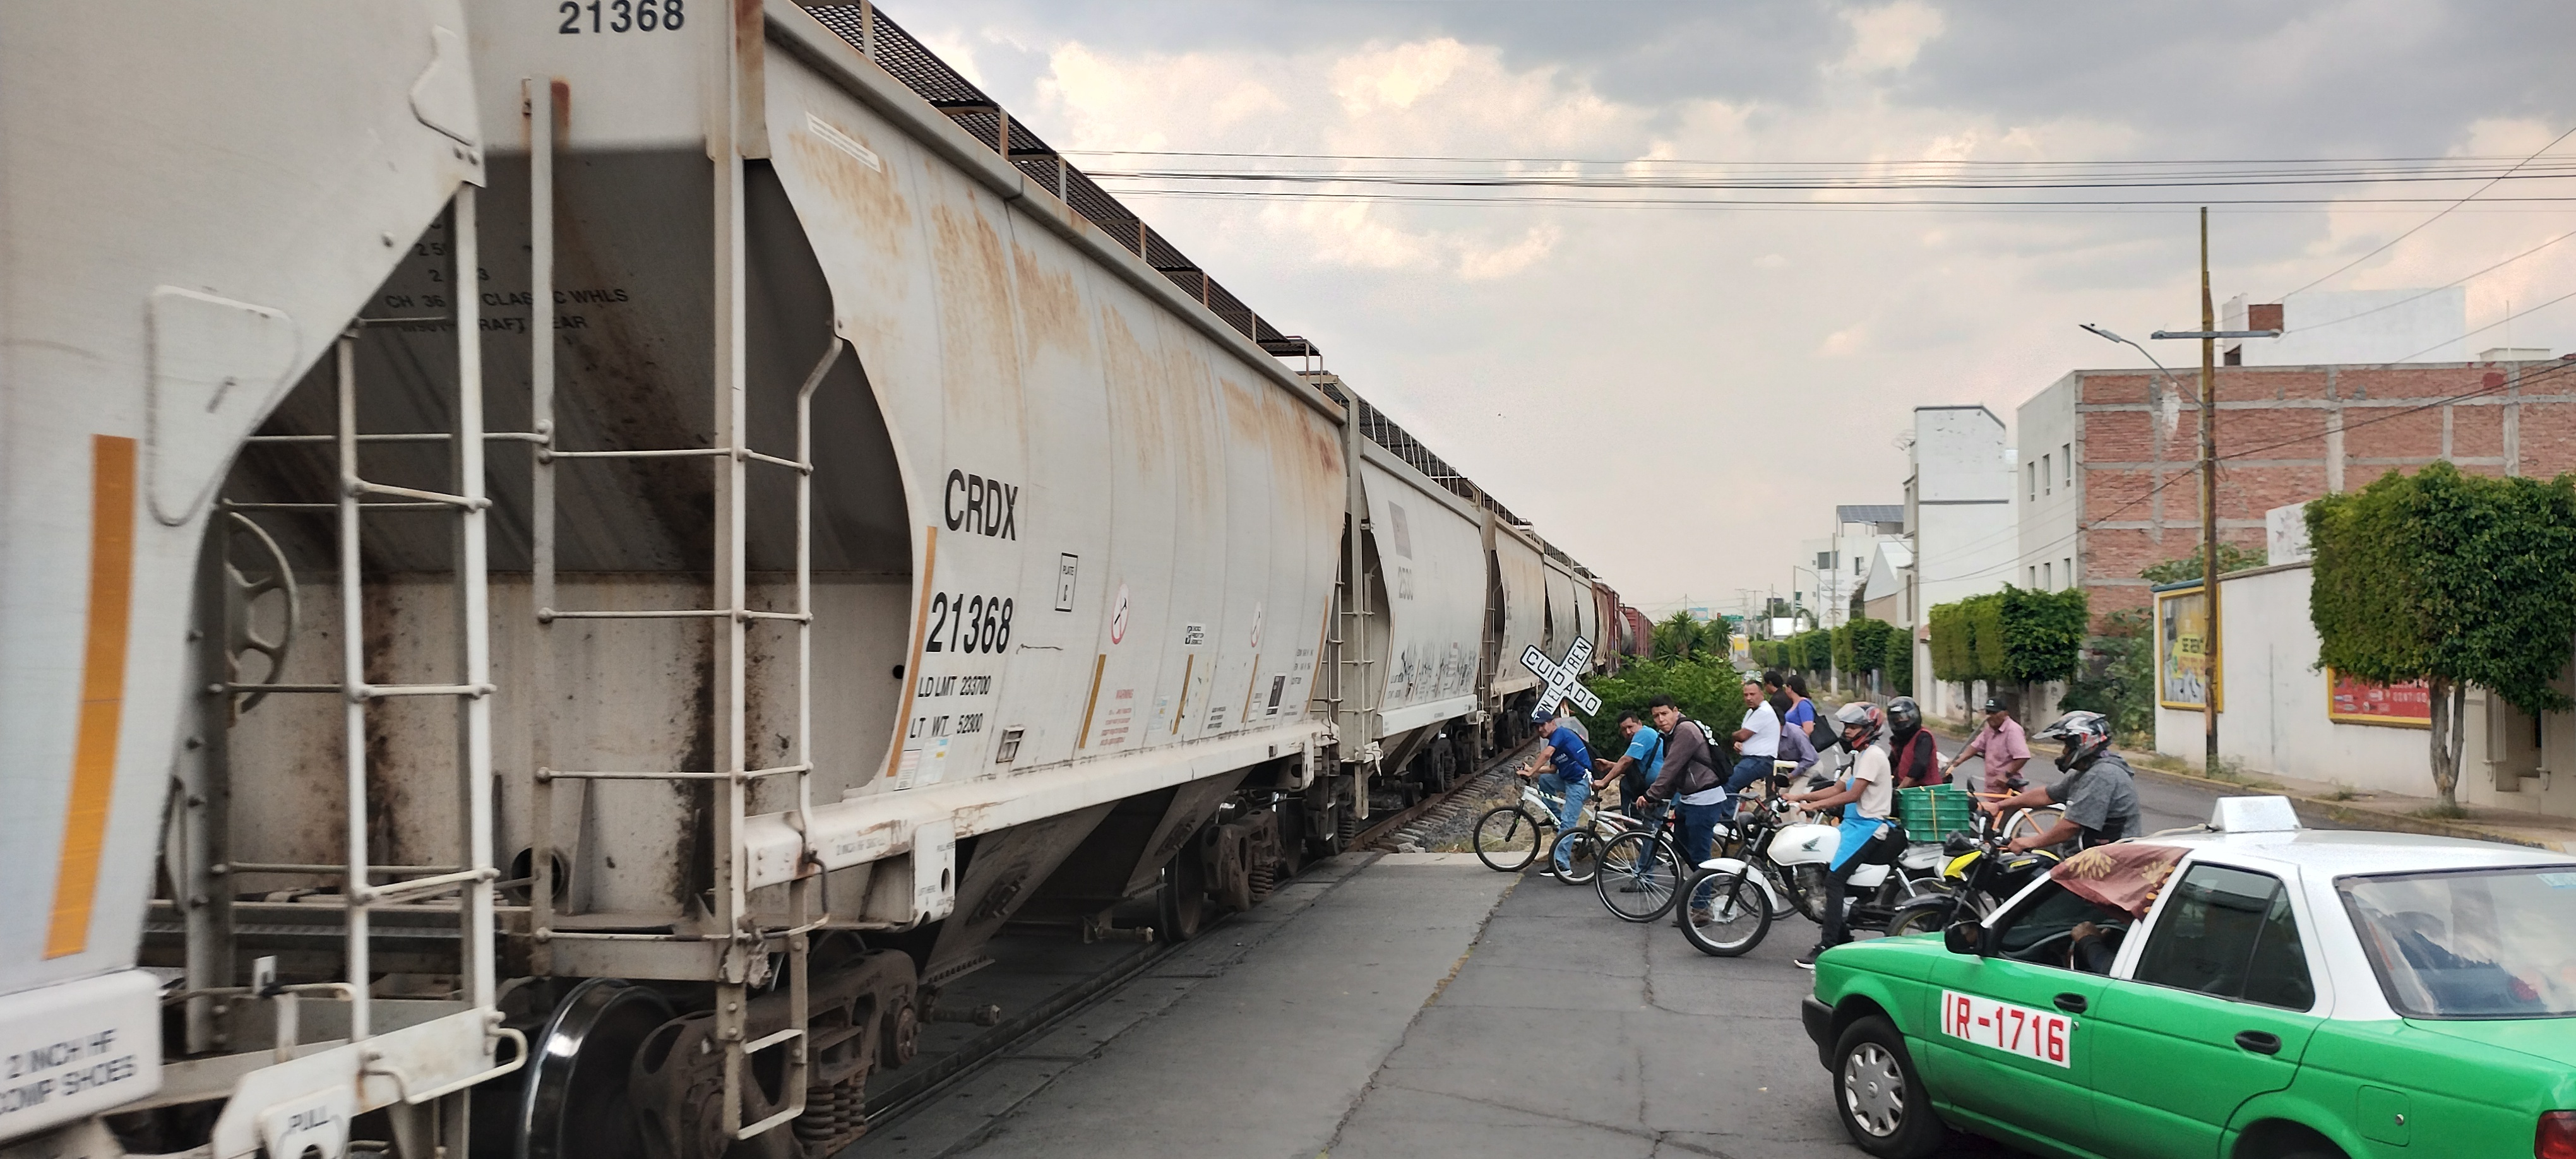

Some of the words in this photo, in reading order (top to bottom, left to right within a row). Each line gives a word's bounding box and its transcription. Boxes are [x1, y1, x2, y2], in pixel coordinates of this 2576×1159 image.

[559, 0, 684, 34] 21368
[569, 288, 629, 304] WHLS
[479, 317, 527, 335] RAFT
[945, 468, 1018, 542] CRDX
[925, 591, 1013, 654] 21368
[918, 677, 934, 698] LD
[1526, 651, 1598, 712] CUIDADO
[1546, 687, 1563, 702] EL
[1561, 641, 1590, 675] TREN
[909, 717, 926, 739] LT
[931, 715, 950, 737] WT
[957, 713, 984, 734] 52300
[1947, 993, 2065, 1062] IR-1716
[62, 1054, 138, 1096] SHOES
